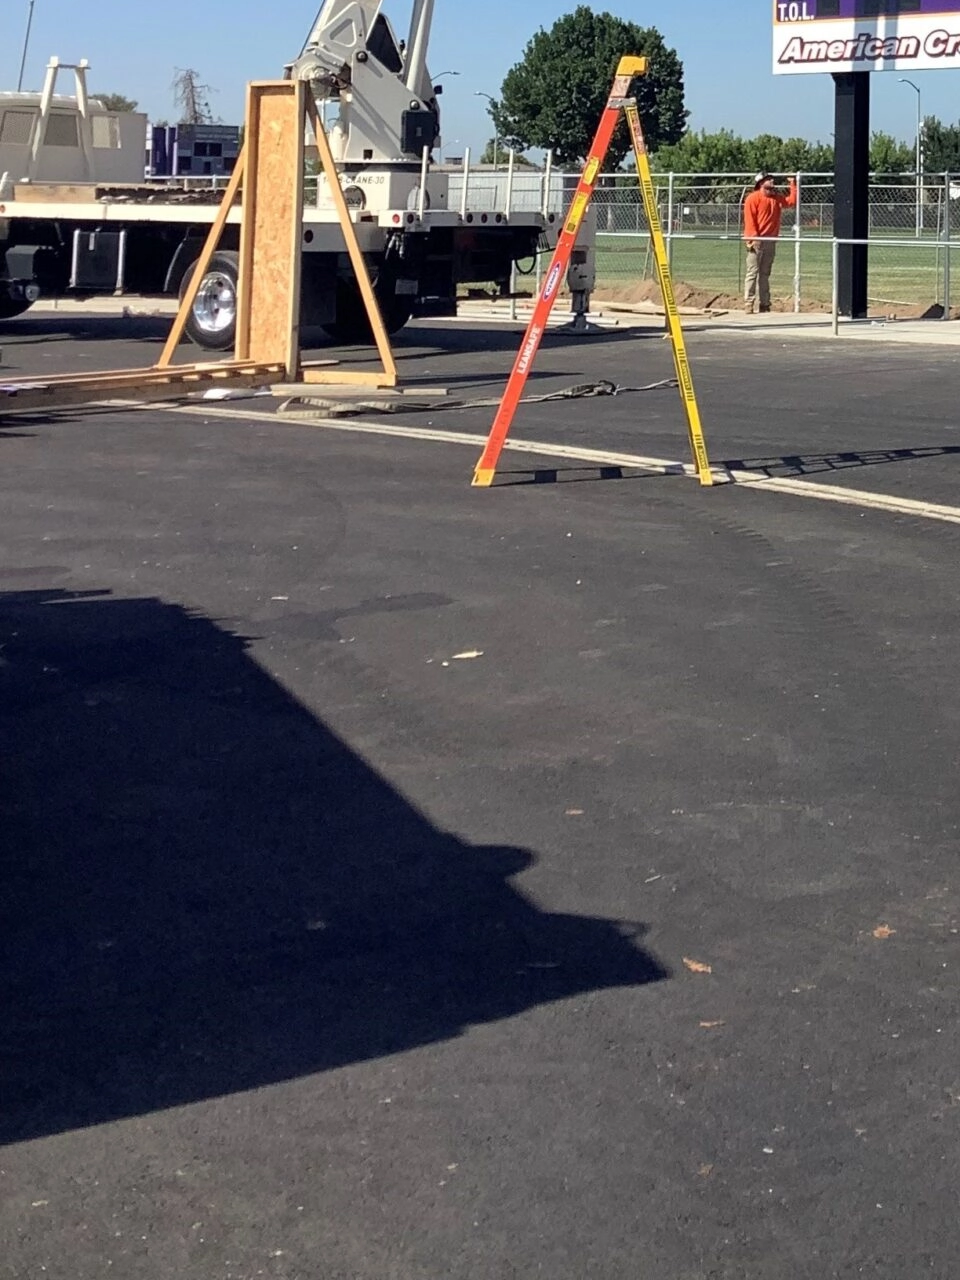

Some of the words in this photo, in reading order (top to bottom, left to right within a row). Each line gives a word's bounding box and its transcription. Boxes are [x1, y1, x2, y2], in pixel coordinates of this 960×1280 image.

[778, 2, 815, 22] T.O.L.
[778, 33, 921, 64] American
[517, 325, 541, 375] LEANSAFE
